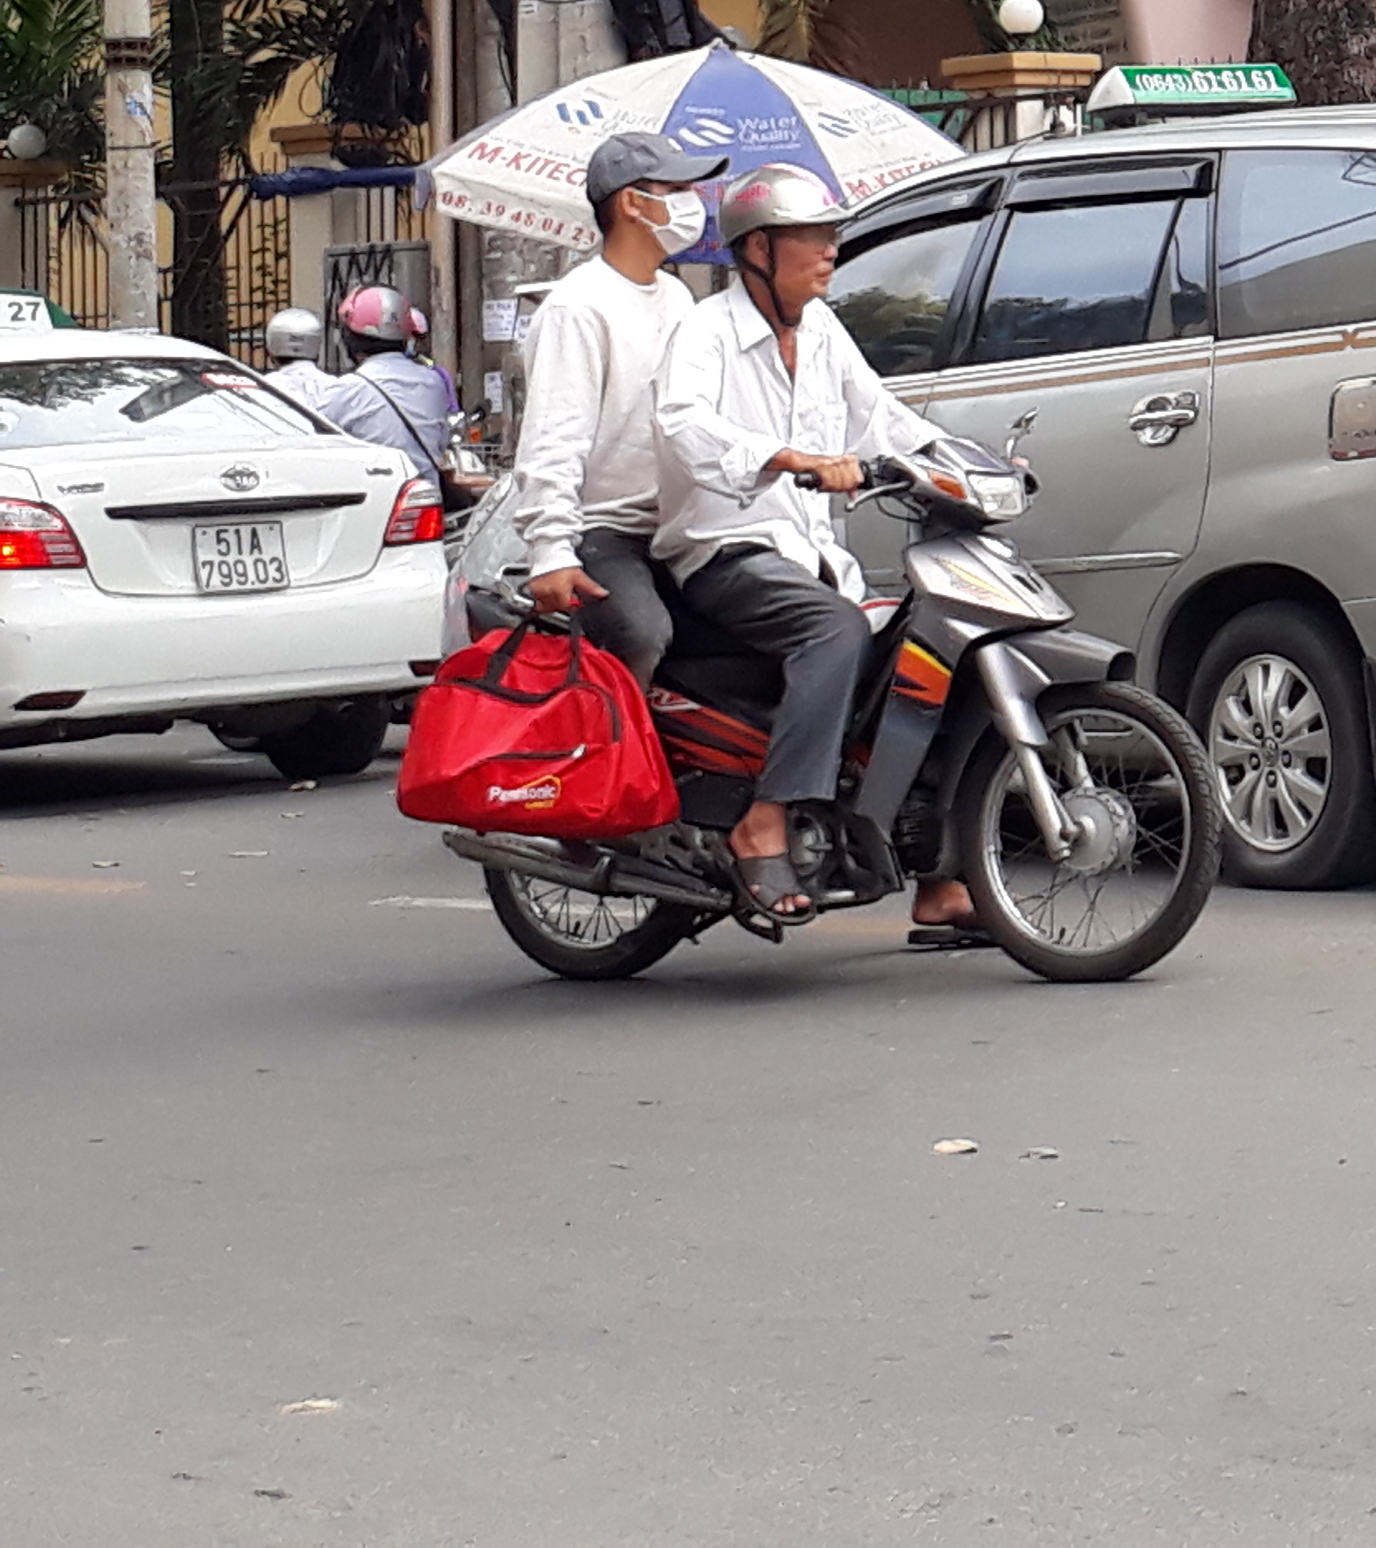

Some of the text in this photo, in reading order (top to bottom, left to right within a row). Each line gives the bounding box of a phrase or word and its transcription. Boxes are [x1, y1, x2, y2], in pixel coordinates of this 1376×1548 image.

[467, 142, 588, 187] M-KITEC
[7, 301, 41, 322] 27
[215, 528, 263, 557] 51A
[201, 557, 284, 588] 799.03
